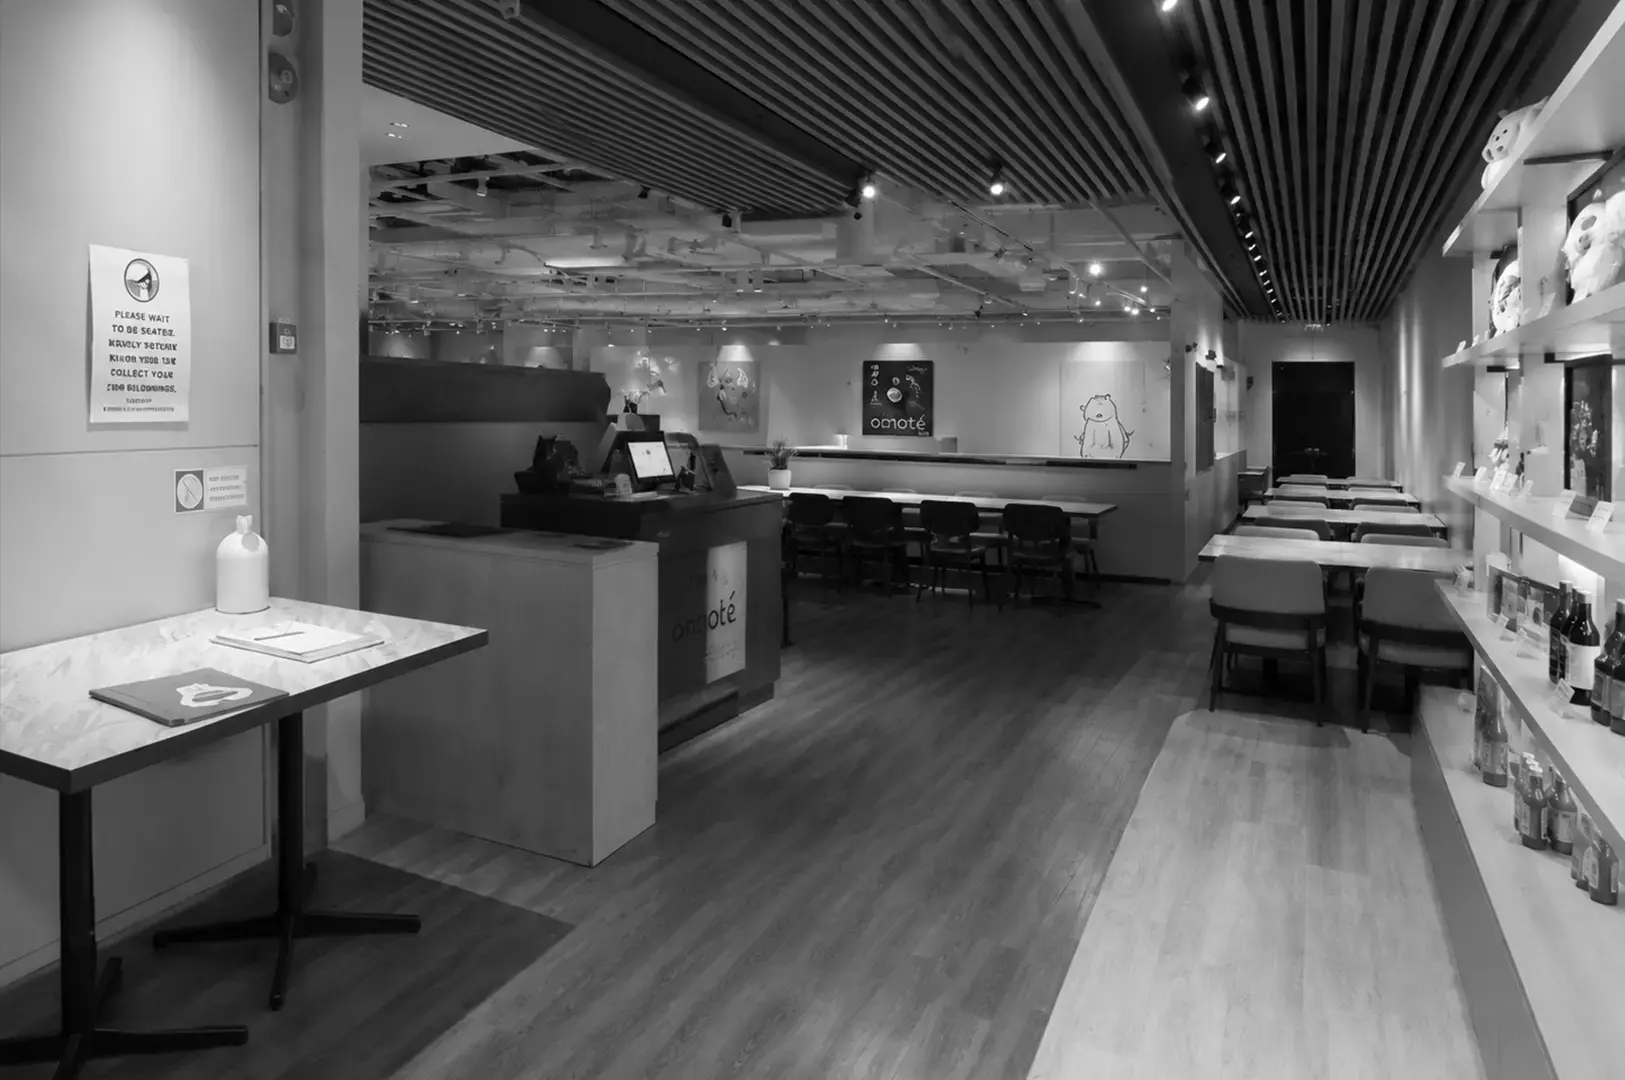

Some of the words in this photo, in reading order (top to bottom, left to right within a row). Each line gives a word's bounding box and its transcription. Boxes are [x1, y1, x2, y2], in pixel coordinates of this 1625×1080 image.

[114, 310, 146, 321] PLEASE
[148, 314, 170, 323] WAIT
[112, 324, 124, 333] TO
[126, 326, 138, 334] BE
[110, 368, 149, 378] COLLECT
[870, 414, 926, 431] omoté
